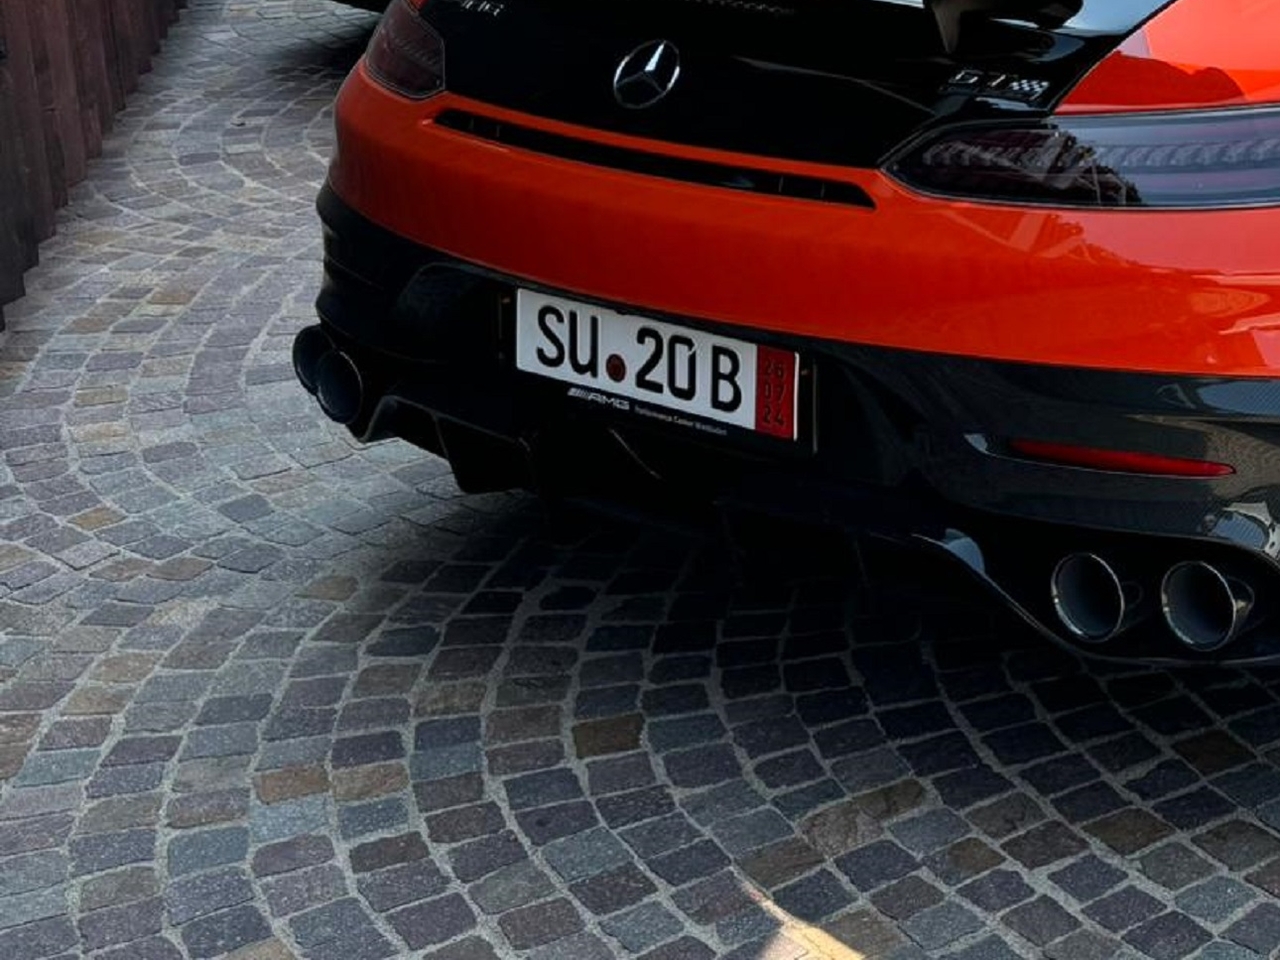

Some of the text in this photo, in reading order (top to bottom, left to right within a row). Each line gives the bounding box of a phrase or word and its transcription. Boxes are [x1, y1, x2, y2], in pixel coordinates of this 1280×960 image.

[536, 304, 742, 412] SU 20 B
[762, 404, 786, 427] 24
